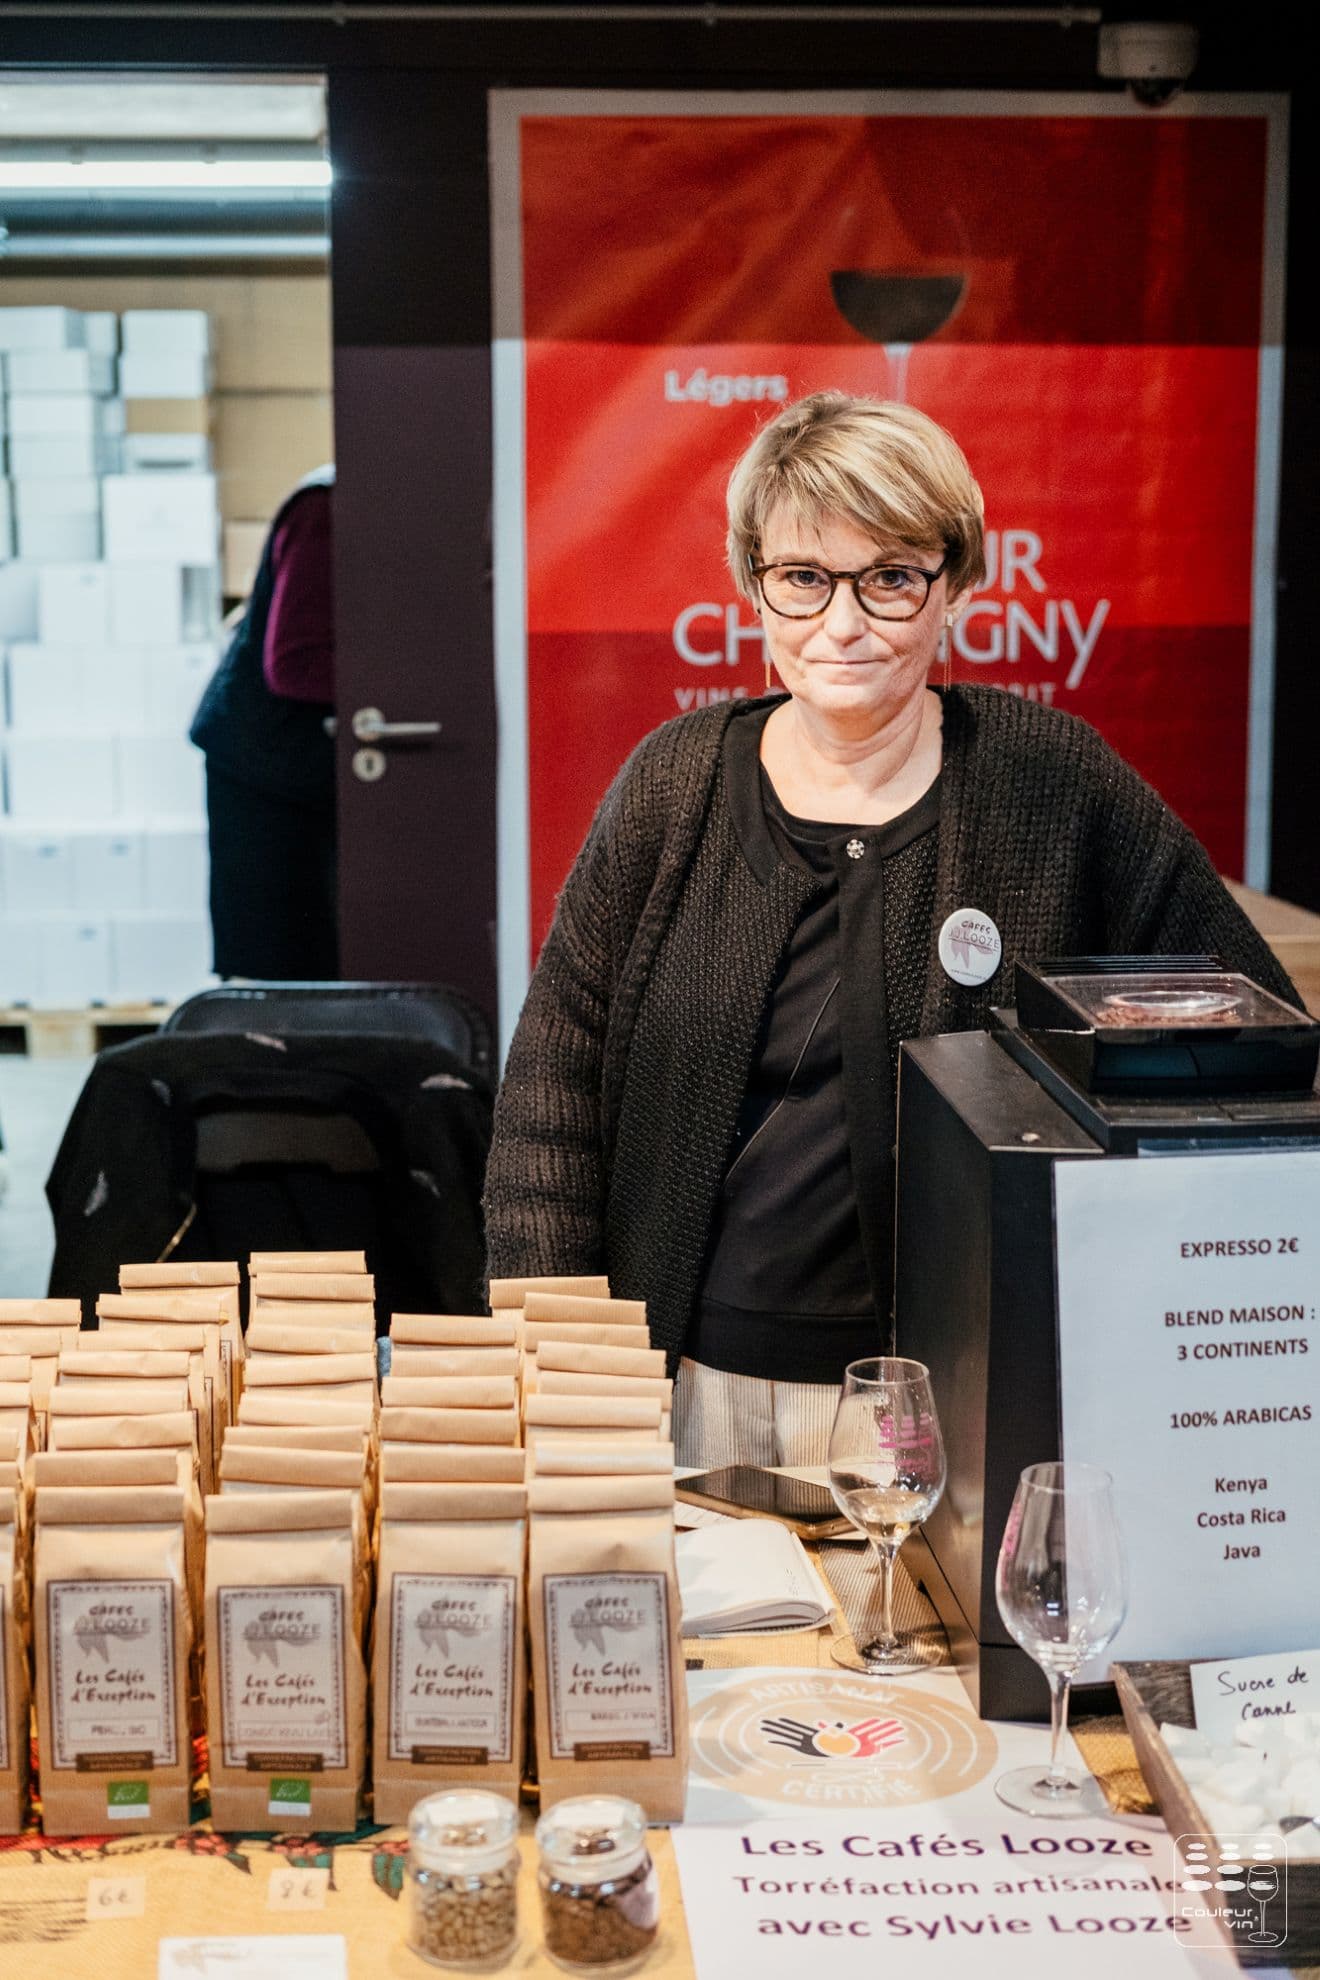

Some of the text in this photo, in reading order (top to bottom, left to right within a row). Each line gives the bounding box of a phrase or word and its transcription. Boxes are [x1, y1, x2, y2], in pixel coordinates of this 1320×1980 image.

[665, 368, 788, 406] Légers
[1180, 1237, 1299, 1258] EXPRESSO 2€
[1165, 1309, 1224, 1327] BLEND
[1229, 1305, 1304, 1325] MAISON
[1177, 1338, 1309, 1361] 3 CONTINENTS
[1170, 1405, 1312, 1429] 100% ARABICAS
[1215, 1477, 1268, 1494] Kenya
[1197, 1507, 1286, 1528] Costa Rica
[1223, 1544, 1261, 1560] Java
[76, 1667, 144, 1687] Les Cafés
[415, 1663, 483, 1681] Les Cafés
[573, 1661, 640, 1679] Les Cafés
[246, 1673, 314, 1690] Les Cafés
[568, 1680, 652, 1697] d'Exception
[1217, 1665, 1309, 1696] Sucre de
[70, 1687, 156, 1704] d'Exception
[241, 1691, 326, 1709] d'Exception
[410, 1682, 493, 1700] d'Exception
[741, 1833, 1153, 1857] Les Cafés Looze
[733, 1875, 1187, 1897] Torréfaction artisanale
[757, 1914, 1193, 1940] avec Sylvie Looze
